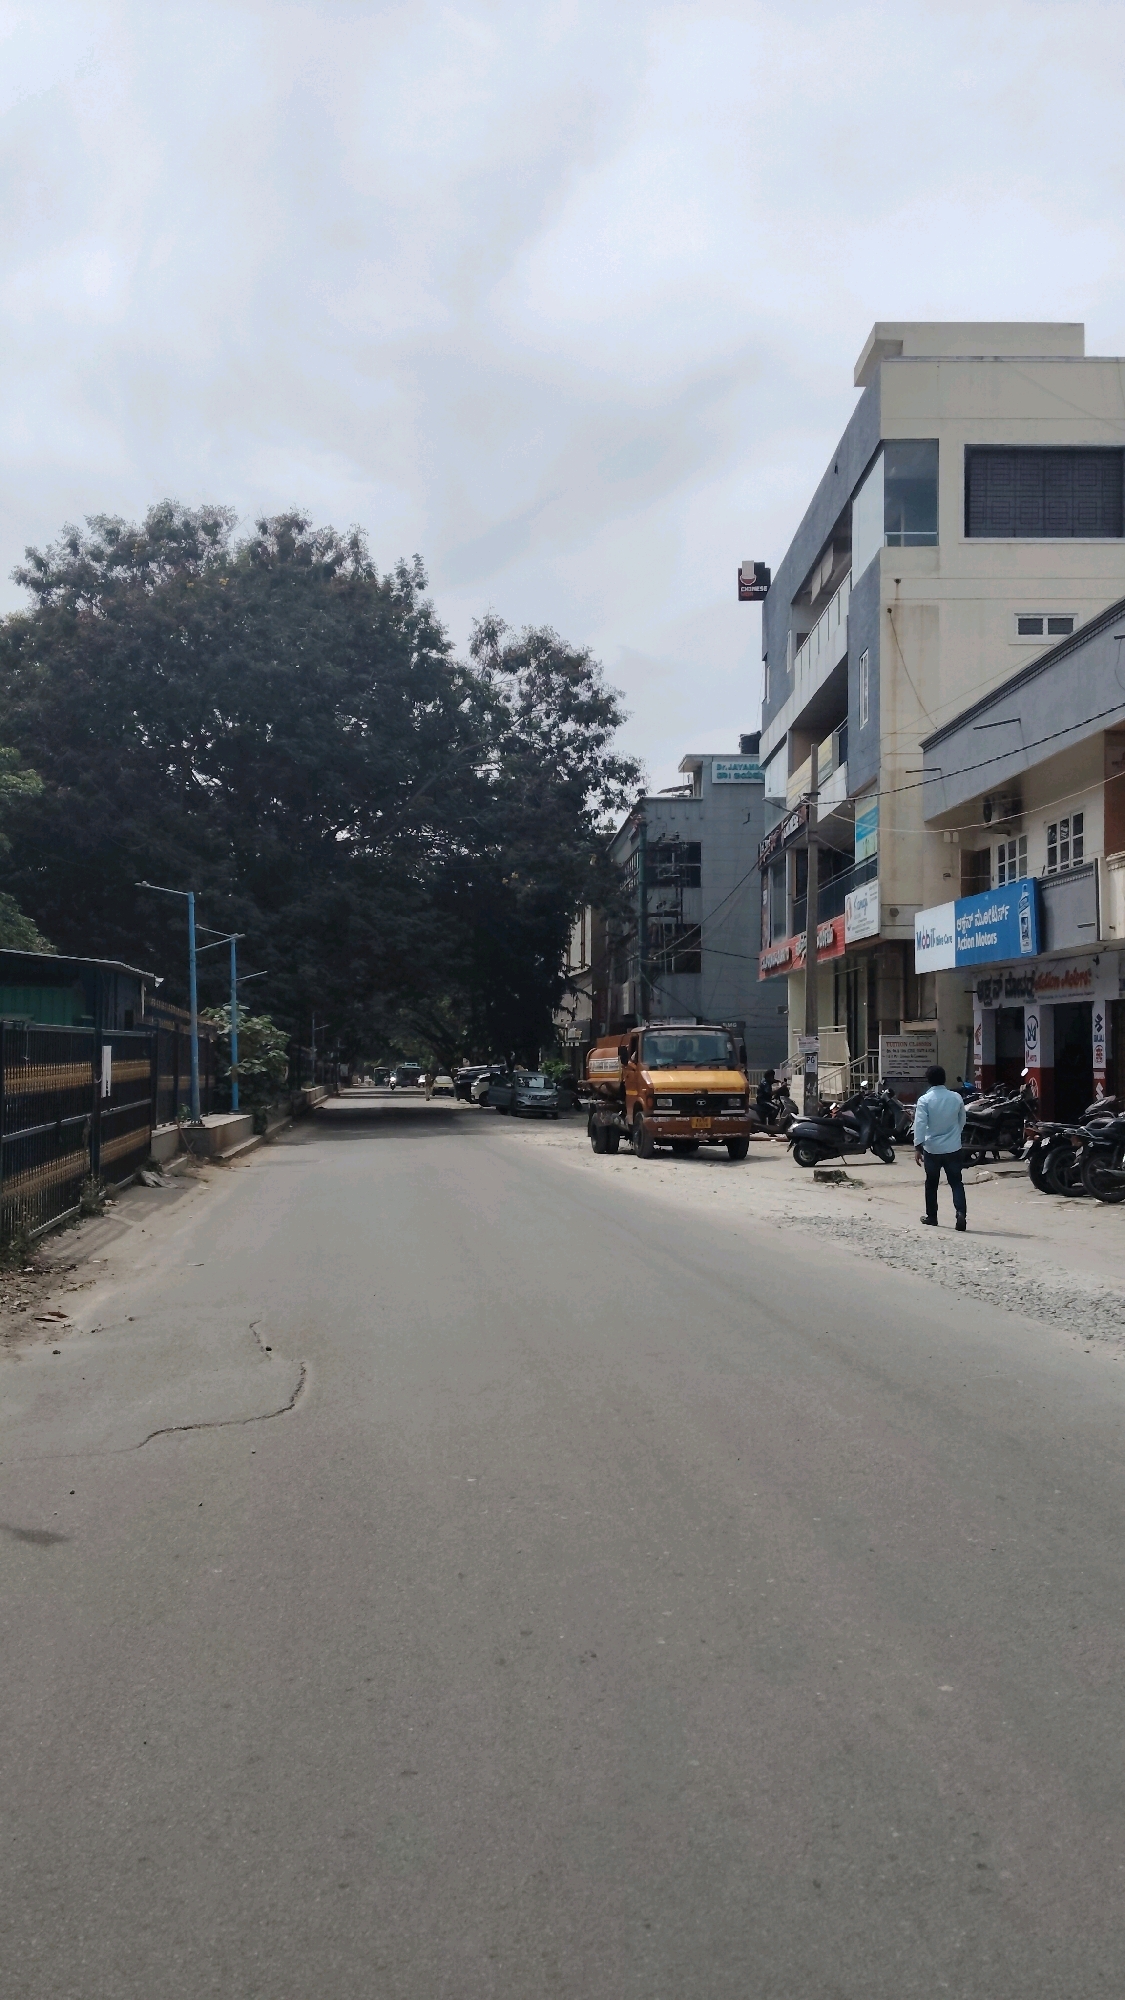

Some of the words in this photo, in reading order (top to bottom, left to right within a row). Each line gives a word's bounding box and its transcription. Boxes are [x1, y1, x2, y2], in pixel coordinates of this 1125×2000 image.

[957, 934, 975, 951] Action
[975, 931, 997, 948] Motors
[806, 1056, 815, 1064] PG
